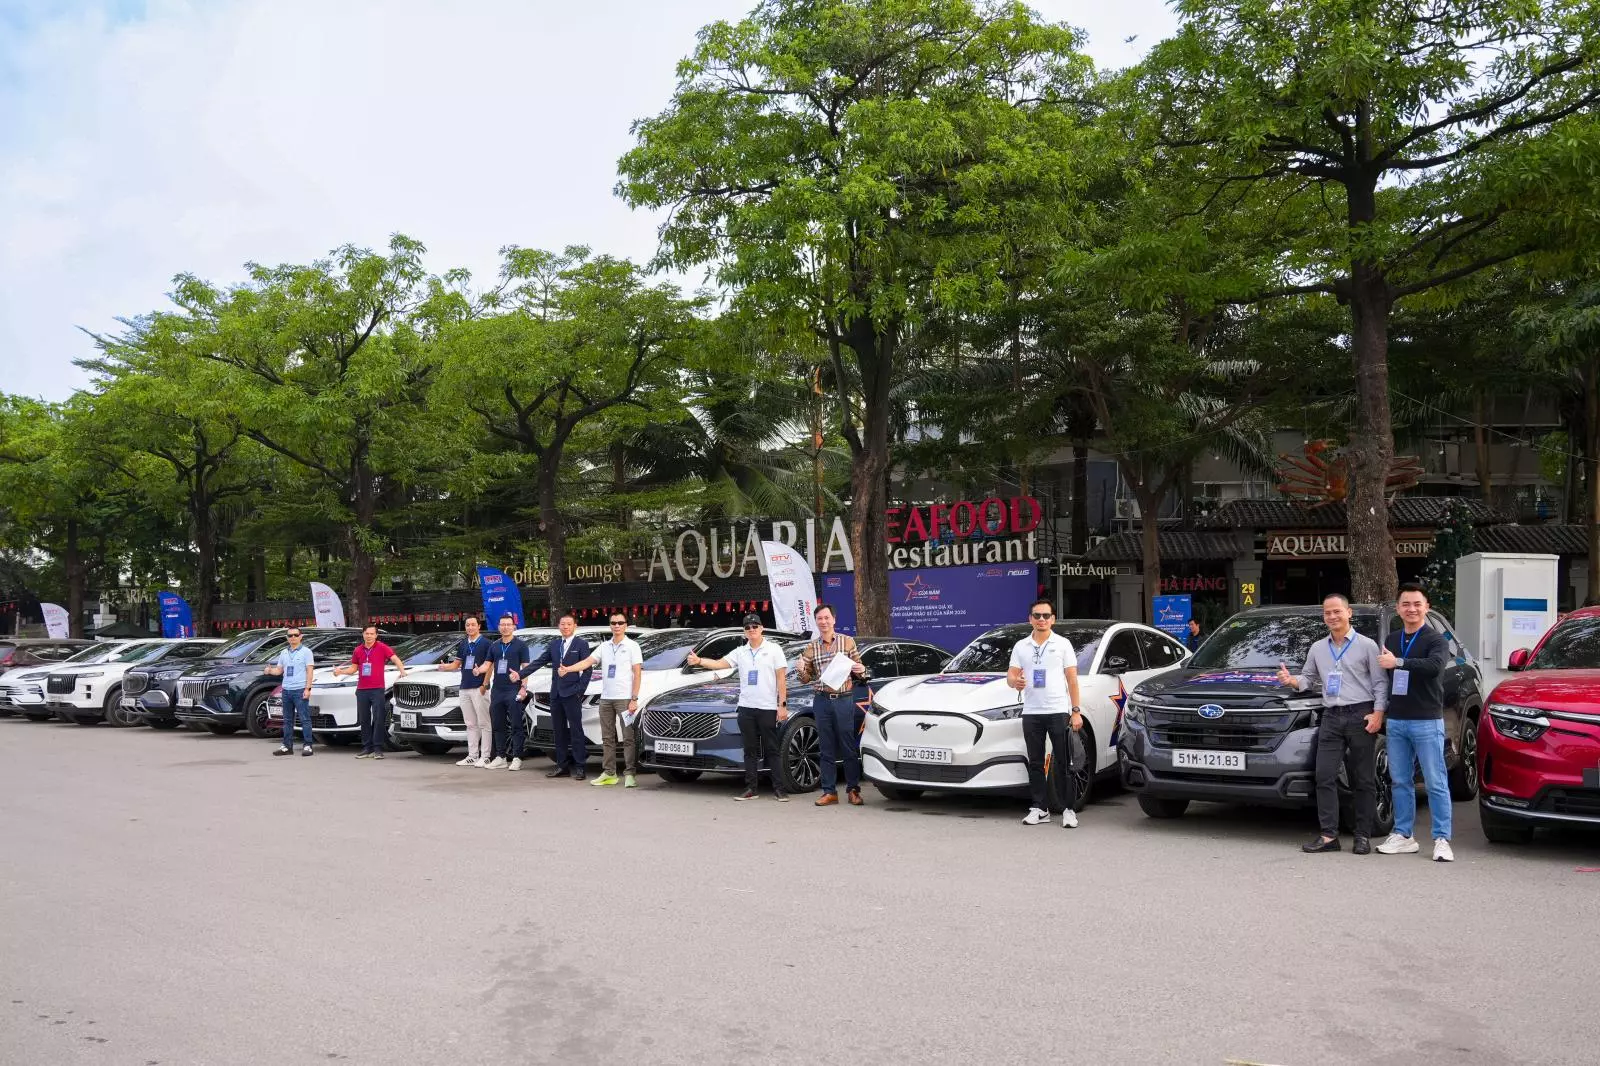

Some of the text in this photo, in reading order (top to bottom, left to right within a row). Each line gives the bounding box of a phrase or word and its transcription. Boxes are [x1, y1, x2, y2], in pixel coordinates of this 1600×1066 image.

[885, 495, 1042, 542] EAFOOD
[1270, 536, 1433, 556] AQUARI CENTR
[568, 562, 622, 584] Lounge
[1059, 562, 1118, 580] Phở Aqua
[1159, 574, 1179, 591] HÀ
[1241, 583, 1255, 594] 29
[1243, 595, 1253, 605] A
[1178, 753, 1239, 766] 51M-121.83
